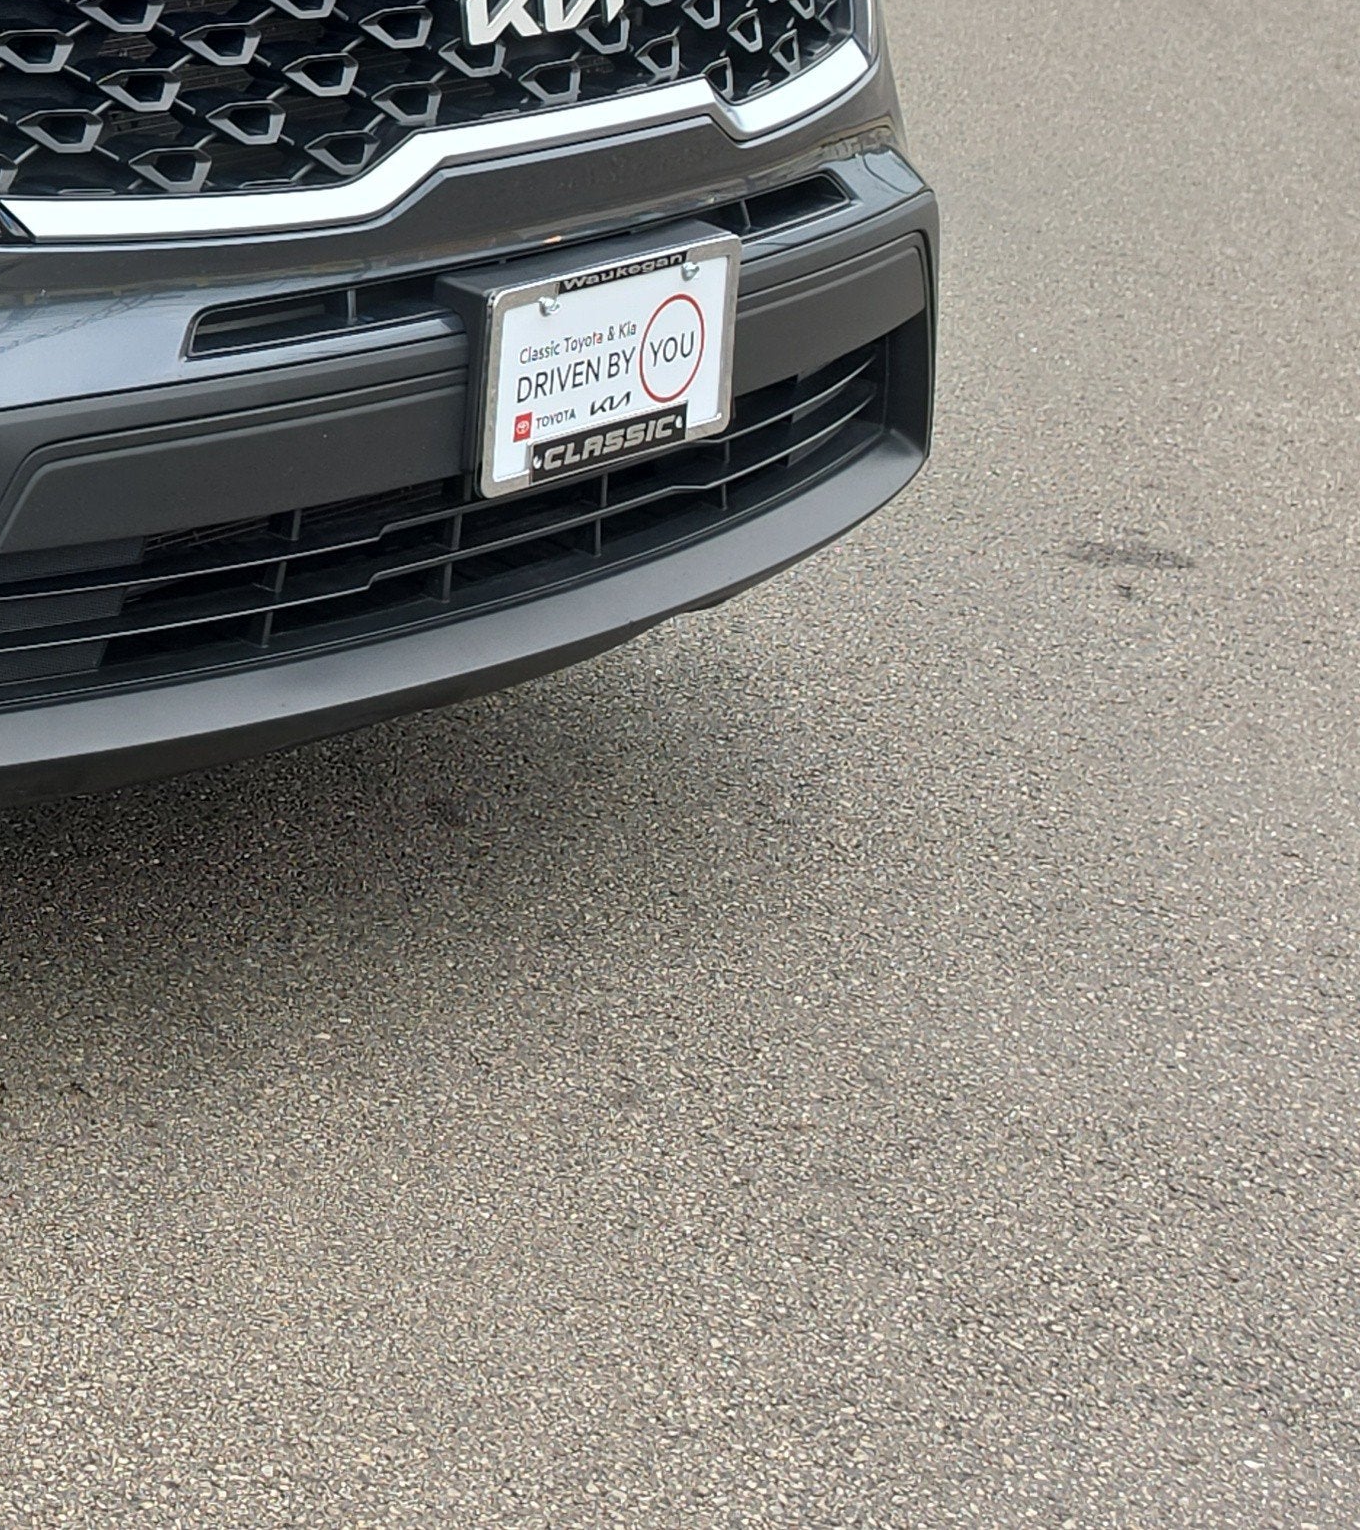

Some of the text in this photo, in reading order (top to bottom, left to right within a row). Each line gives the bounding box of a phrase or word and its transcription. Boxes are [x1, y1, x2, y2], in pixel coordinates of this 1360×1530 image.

[563, 253, 684, 291] Waukegan
[519, 320, 638, 365] Classic Toyota & Kia
[516, 330, 696, 404] DRIVEN BY YOU
[535, 390, 632, 430] TOYOTA KIA
[543, 413, 676, 471] CLASSIC
